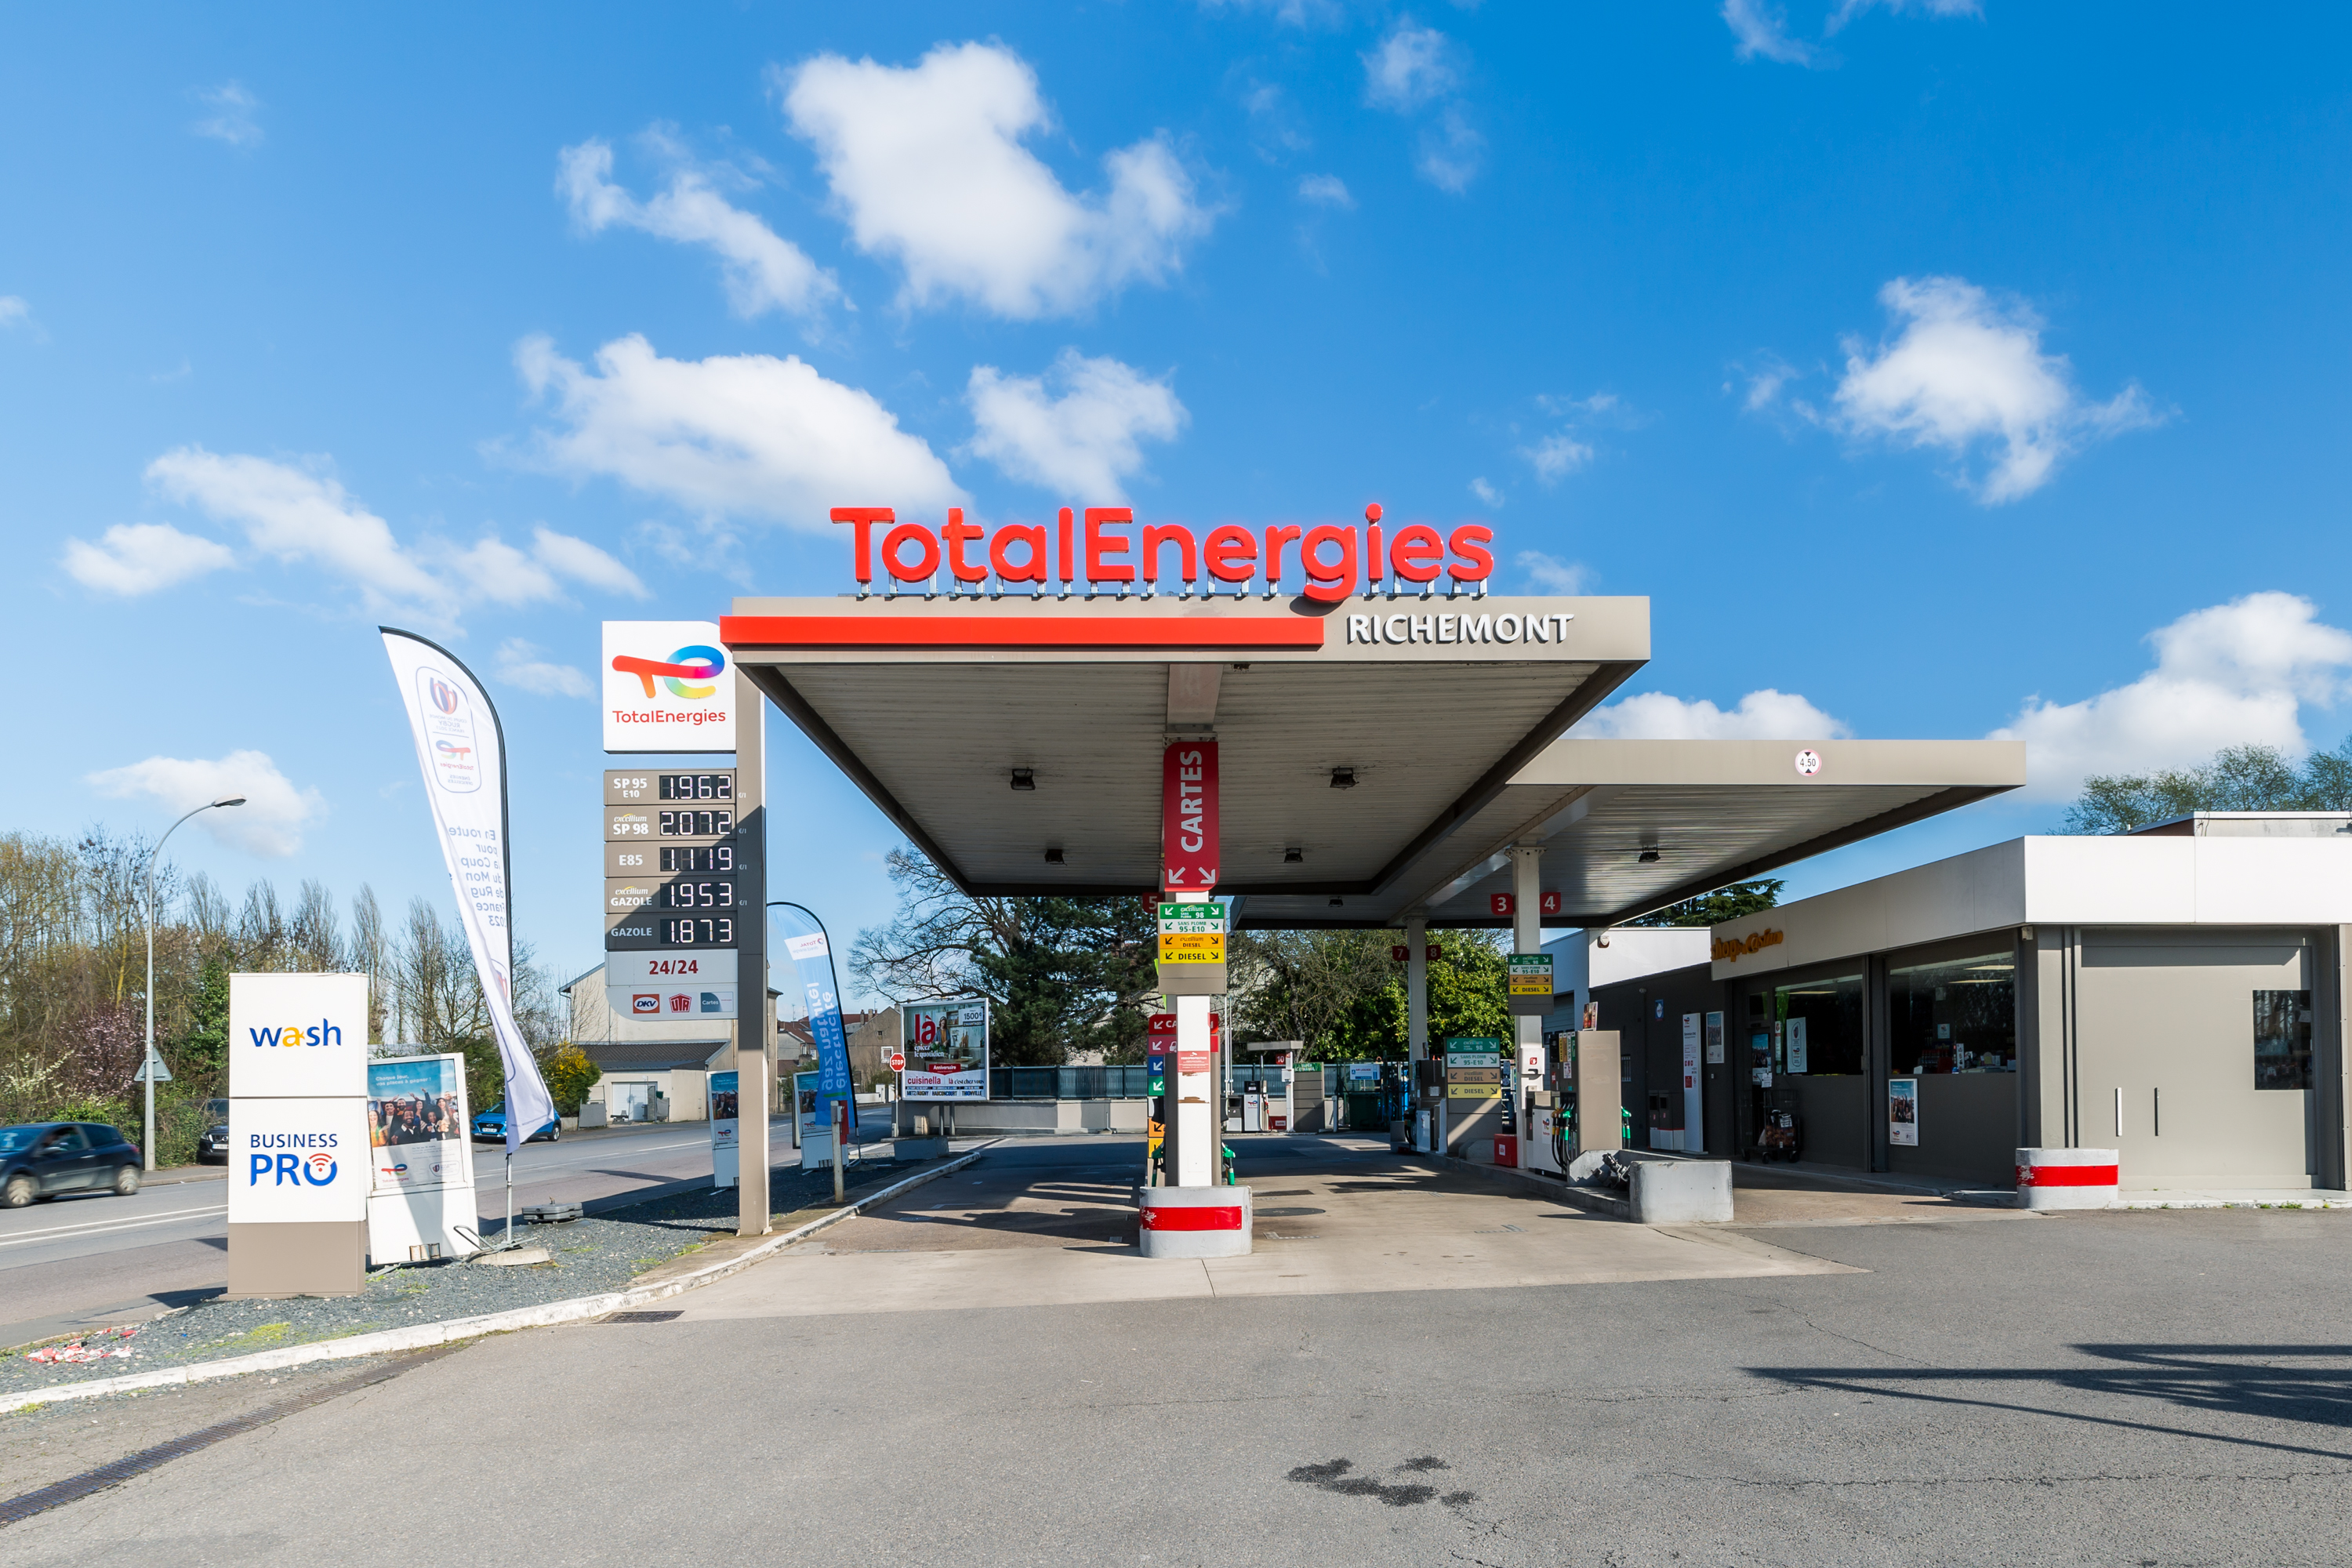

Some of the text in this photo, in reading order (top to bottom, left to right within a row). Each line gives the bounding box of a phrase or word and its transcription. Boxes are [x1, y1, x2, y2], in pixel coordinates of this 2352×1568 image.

[830, 503, 1494, 603] TotalEnergies
[1348, 613, 1574, 644] RICHEMONT
[612, 709, 726, 725] TotalEnergies
[1800, 758, 1817, 767] 4.50
[613, 779, 648, 789] SP 95
[670, 775, 731, 800] 1.962
[1180, 750, 1203, 853] CARTES
[614, 814, 648, 822] excellium
[660, 811, 731, 836] 2.072
[613, 823, 649, 835] SP 98
[619, 855, 643, 866] E85
[670, 847, 732, 872] 1.119
[615, 887, 648, 895] excellium
[670, 883, 732, 907] 1.953
[611, 897, 652, 906] GAZOLE
[1149, 895, 1157, 909] 5
[1497, 897, 1507, 911] 3
[1544, 895, 1555, 909] 4
[611, 927, 652, 937] GAZOLE
[670, 919, 732, 943] 1.873
[1397, 949, 1403, 958] 7
[1430, 948, 1437, 957] 8
[649, 960, 699, 975] 24/24
[249, 1018, 341, 1047] wash
[915, 1014, 936, 1045] là
[907, 1076, 941, 1084] cuisinella
[250, 1134, 338, 1148] BUSINESS
[250, 1153, 338, 1186] PRO
